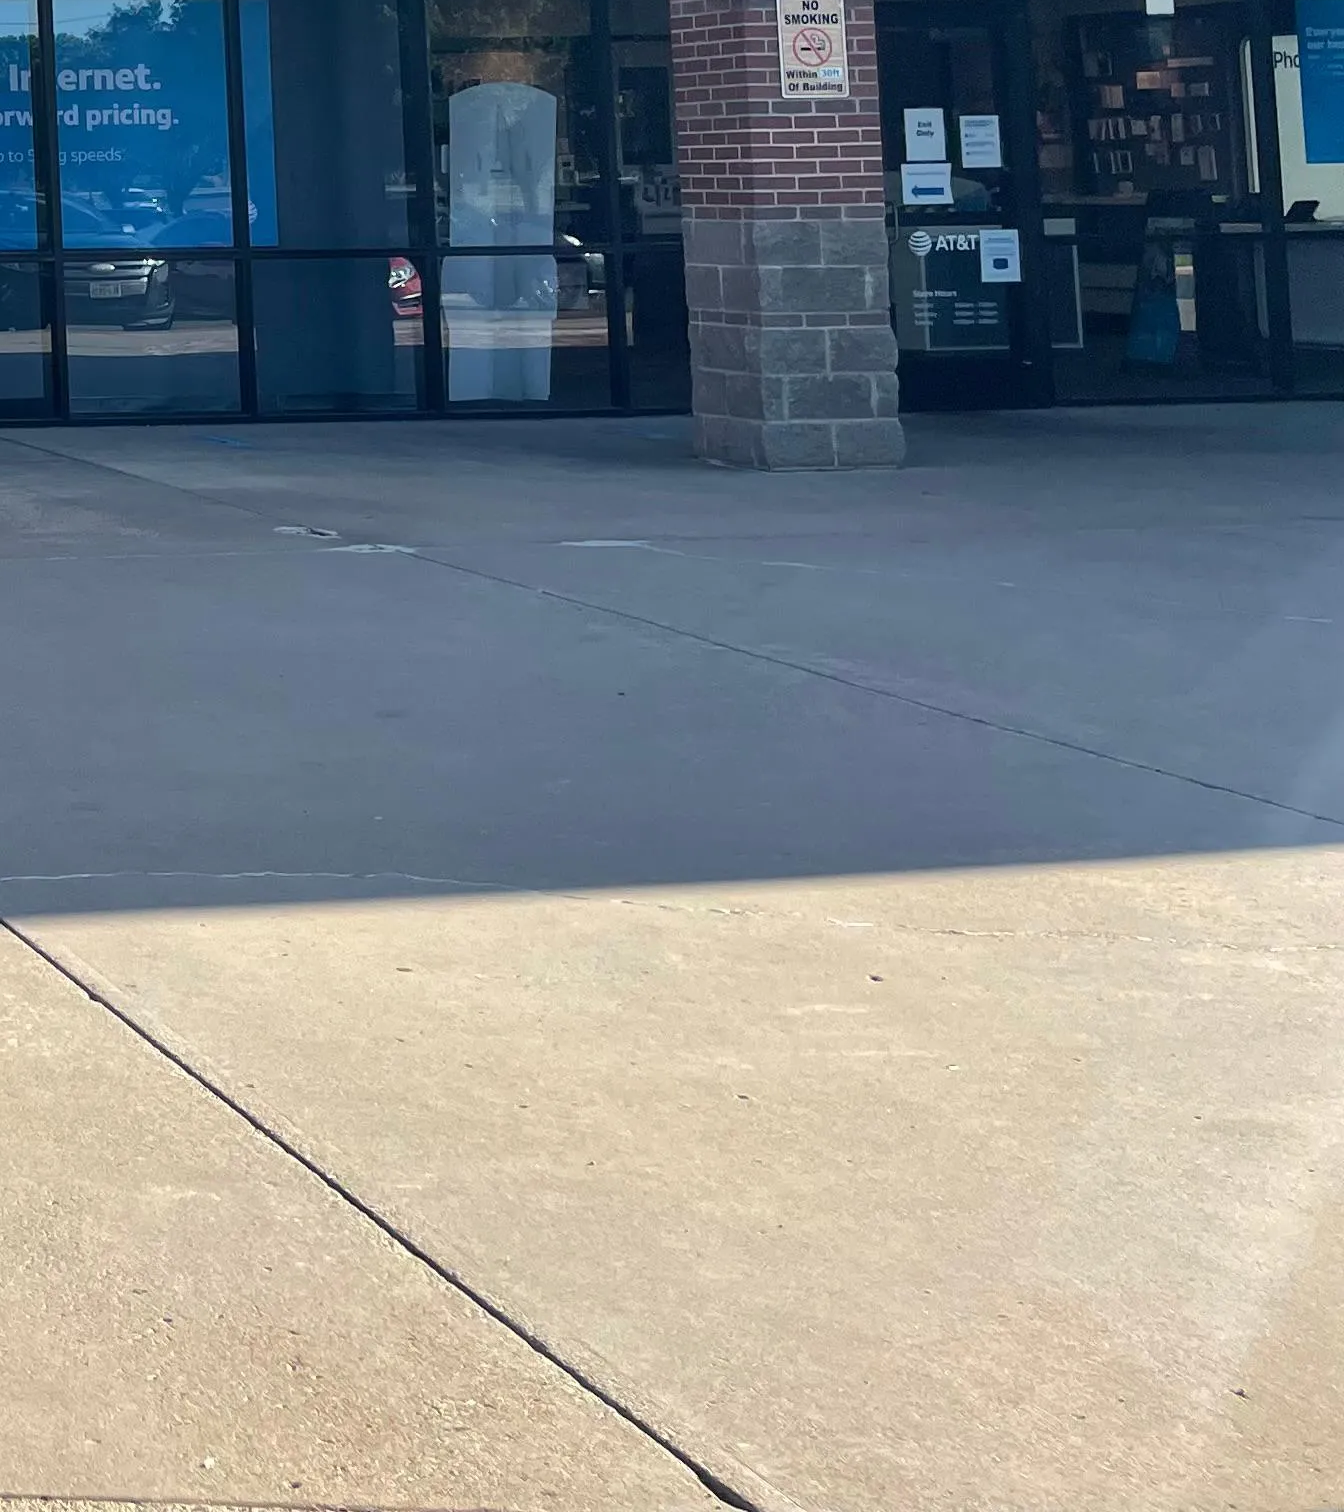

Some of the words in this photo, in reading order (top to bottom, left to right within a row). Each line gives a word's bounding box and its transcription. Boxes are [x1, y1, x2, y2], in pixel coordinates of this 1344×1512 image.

[801, 0, 819, 11] NO
[784, 13, 839, 25] SMOKING
[9, 63, 162, 92] Inernet.
[785, 70, 818, 80] Within
[788, 82, 800, 92] Of
[802, 82, 843, 93] Building
[85, 103, 180, 131] pricing.
[8, 151, 24, 163] to
[935, 234, 980, 252] AT&T
